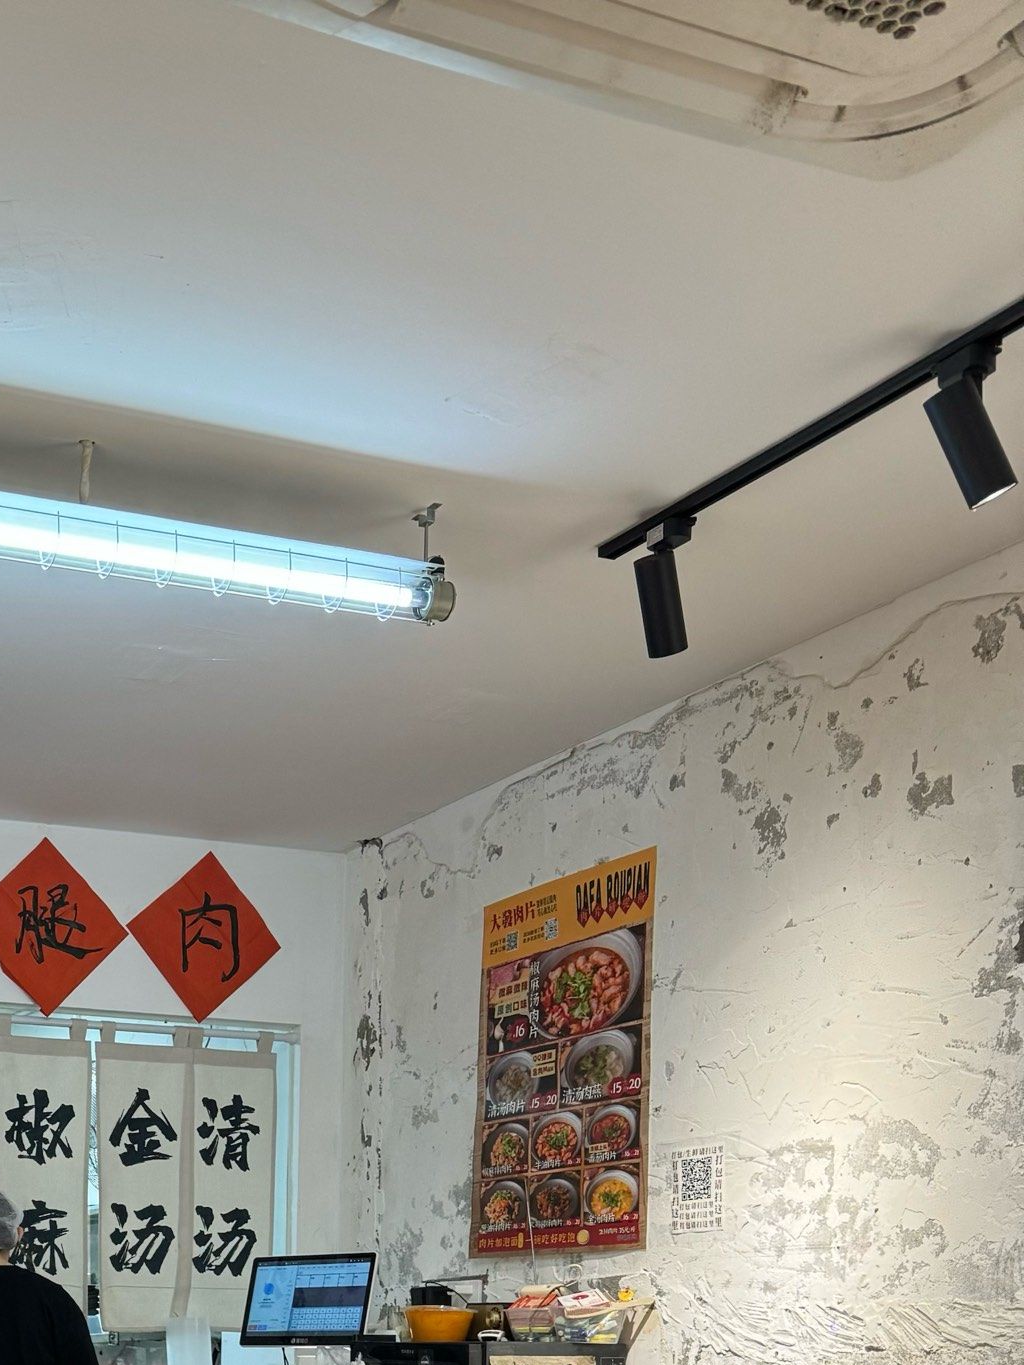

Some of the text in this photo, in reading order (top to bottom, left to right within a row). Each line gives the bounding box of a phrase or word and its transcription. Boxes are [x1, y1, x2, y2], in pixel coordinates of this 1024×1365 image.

[5, 1089, 75, 1275] 椒麻
[108, 1087, 178, 1271] 金汤
[191, 1094, 261, 1278] 清汤
